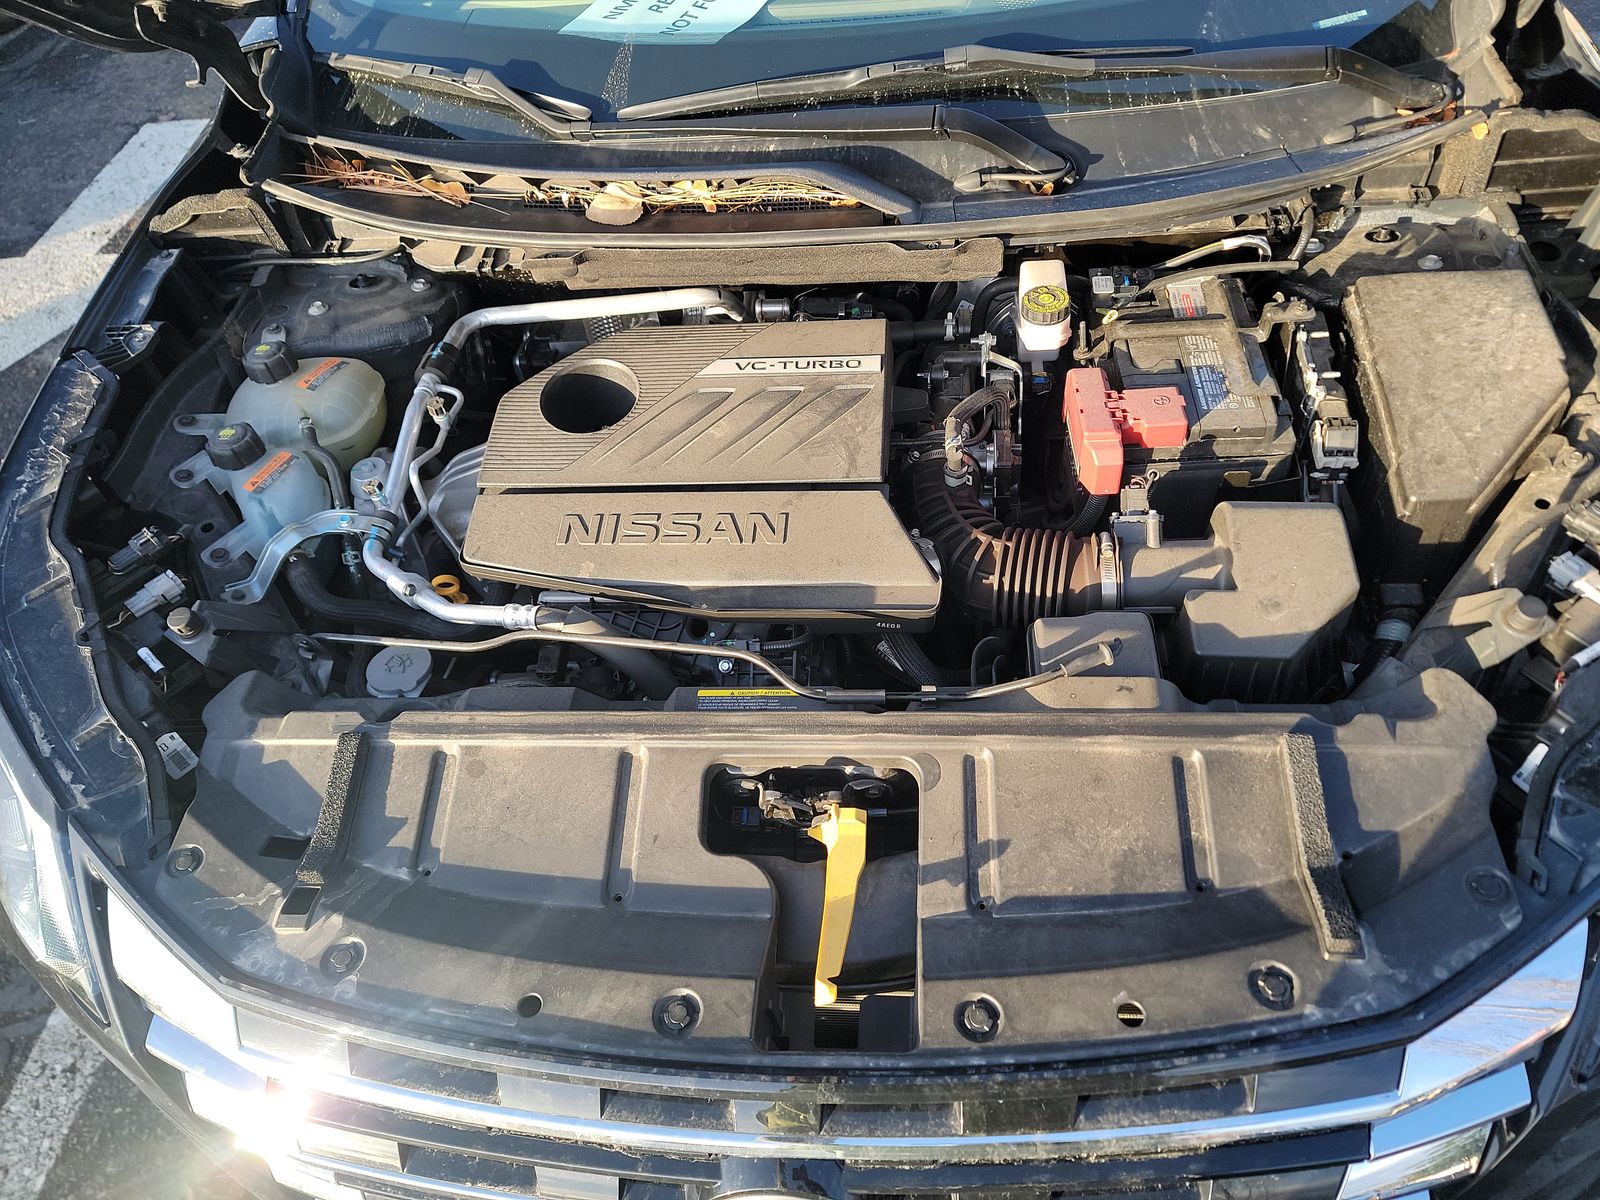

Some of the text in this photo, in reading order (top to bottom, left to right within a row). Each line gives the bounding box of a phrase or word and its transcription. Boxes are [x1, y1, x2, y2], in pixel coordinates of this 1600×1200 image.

[659, 11, 699, 36] NOT
[735, 359, 862, 371] VC-TURBO
[556, 511, 790, 546] NISSAN
